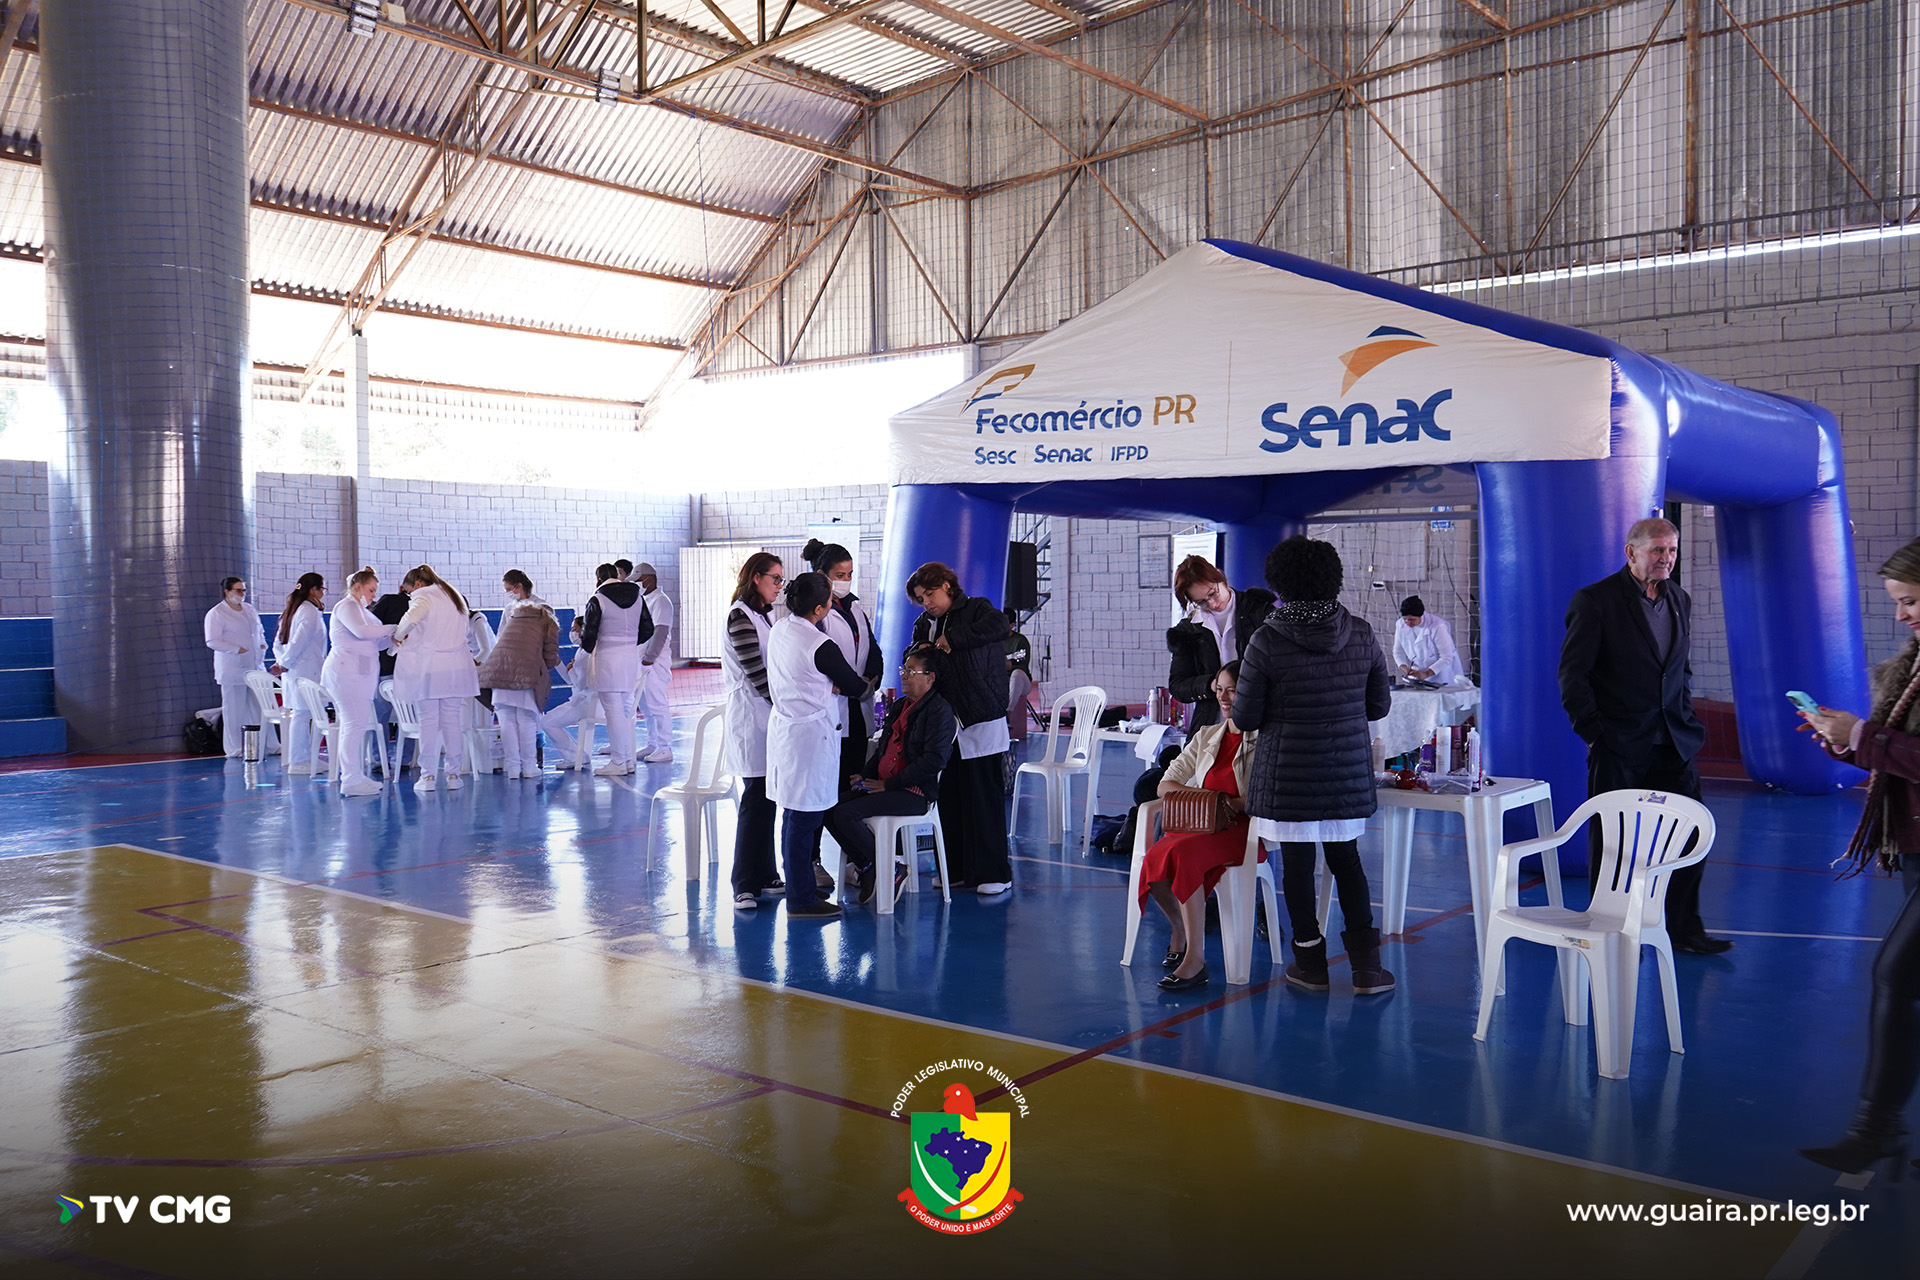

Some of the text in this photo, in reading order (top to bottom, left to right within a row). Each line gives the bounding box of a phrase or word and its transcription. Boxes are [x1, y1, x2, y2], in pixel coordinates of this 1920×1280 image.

[975, 393, 1197, 434] Fecomércio PR
[1259, 388, 1452, 453] Senac
[975, 444, 1149, 465] Sesc Senac IFPD
